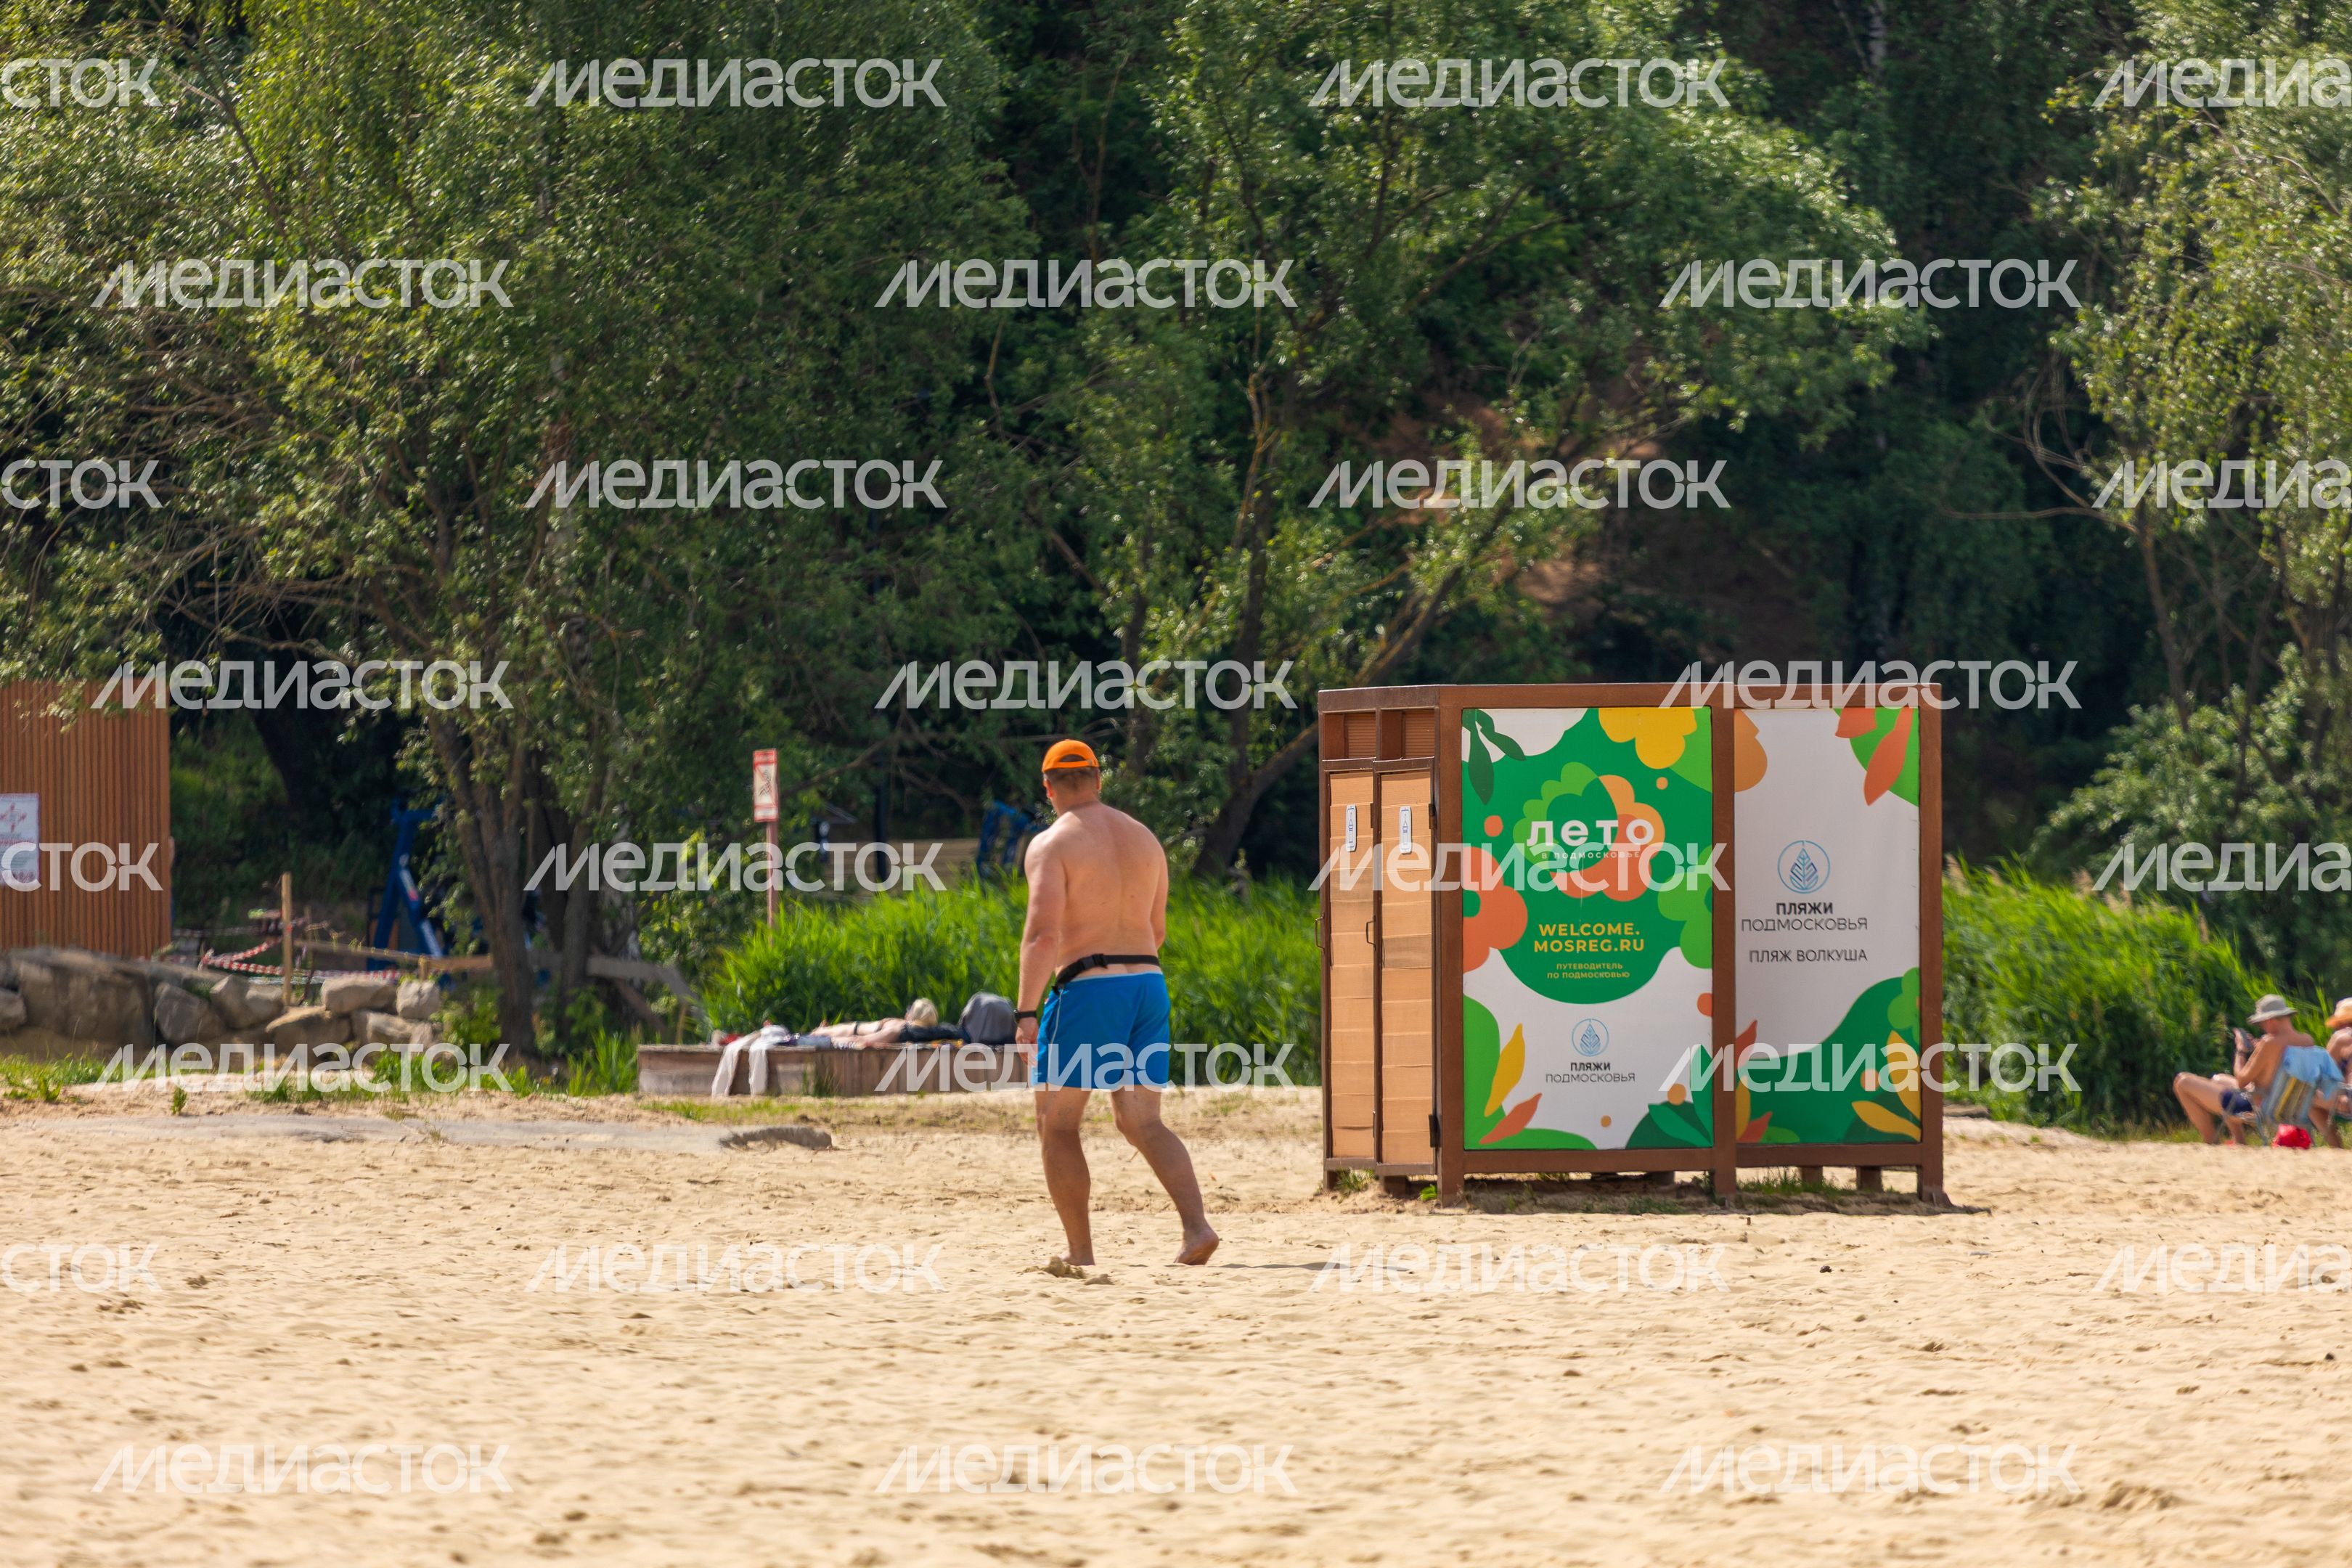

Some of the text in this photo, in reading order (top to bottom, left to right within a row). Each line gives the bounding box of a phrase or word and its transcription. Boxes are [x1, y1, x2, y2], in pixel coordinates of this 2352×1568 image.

[1776, 902, 1834, 915] ПЛЯЖИ
[1538, 923, 1640, 936] WELCOME.
[1741, 918, 1868, 932] ПОДМОСКОВЬЯ
[1534, 939, 1644, 952] MOSREG.RU
[1749, 949, 1869, 963] ПЛЯЖ ВОЛКУША
[1570, 1062, 1611, 1072] ПЛЯЖИ
[1545, 1073, 1636, 1083] ПОДМОСКОВЬЯ
